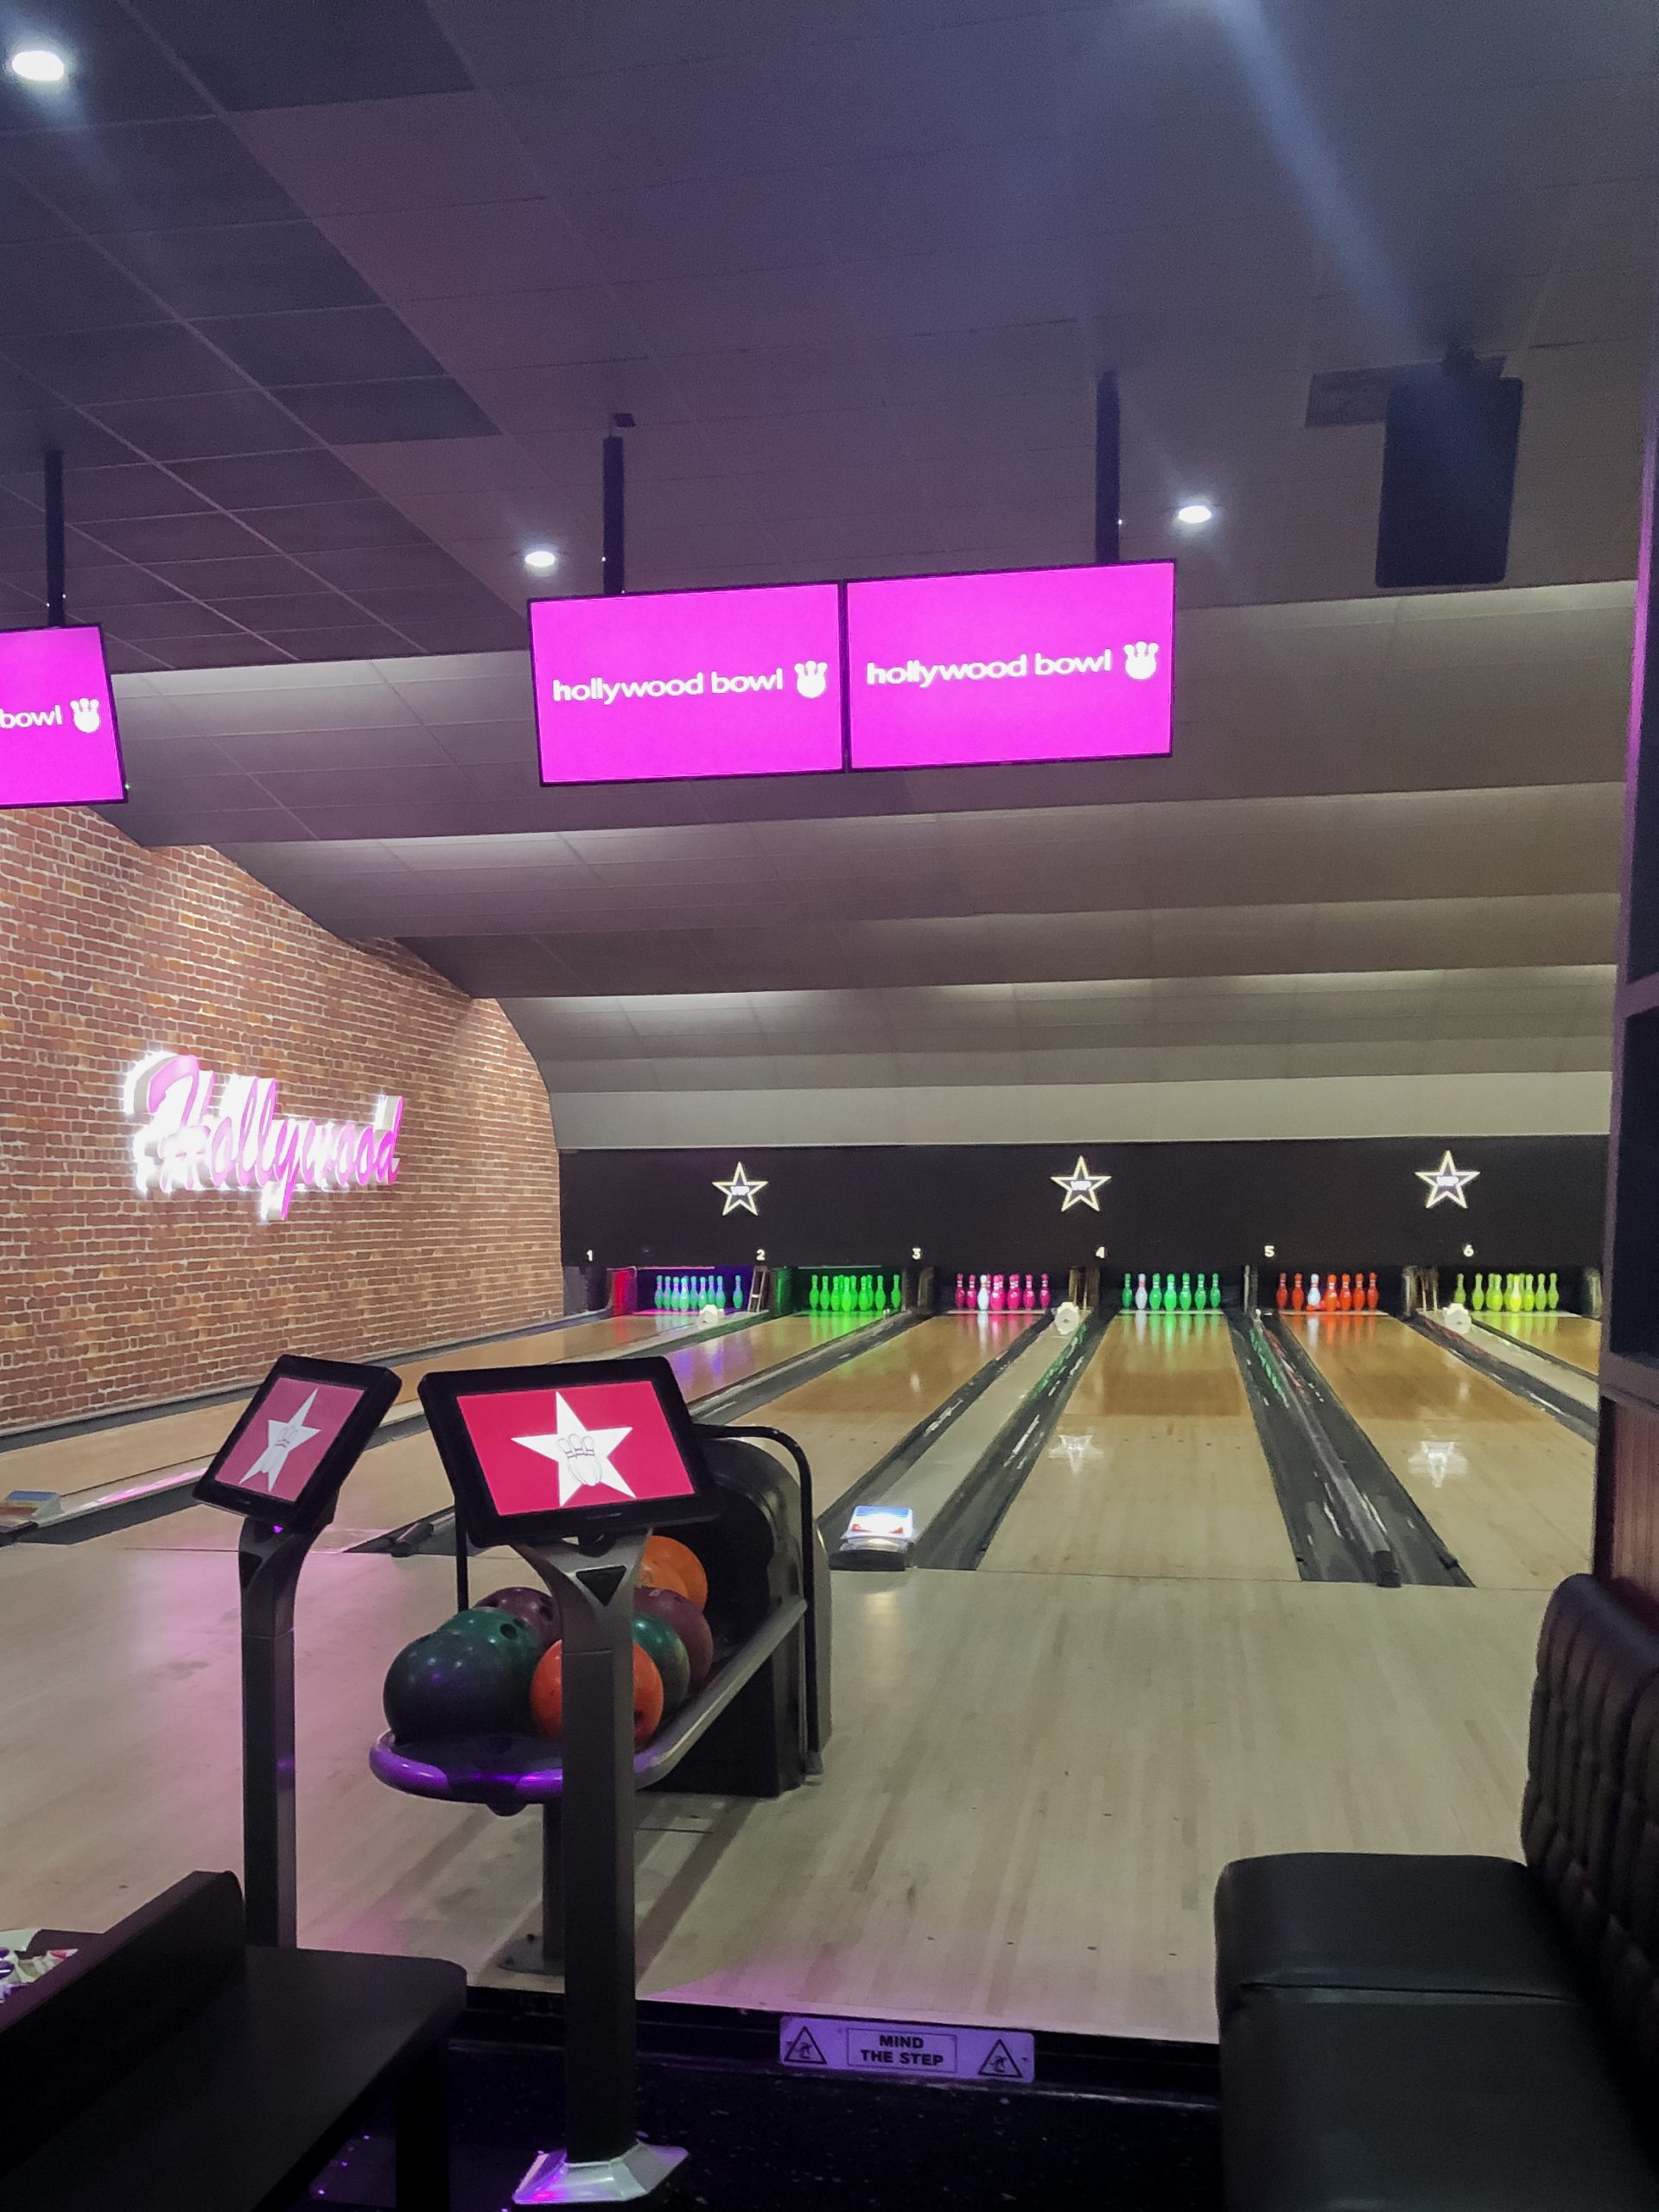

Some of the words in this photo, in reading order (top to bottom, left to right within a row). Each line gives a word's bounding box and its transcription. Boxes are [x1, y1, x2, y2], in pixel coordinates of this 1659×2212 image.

[866, 653, 1029, 689] hollywood
[1033, 648, 1113, 677] bowl
[552, 671, 705, 706] hollywood
[710, 667, 784, 694] bowl
[0, 705, 63, 729] bowl
[128, 1053, 404, 1221] Hollywood
[586, 1249, 594, 1262] 1
[756, 1249, 766, 1262] 2
[912, 1247, 921, 1260] 3
[1095, 1246, 1105, 1259] 4
[1264, 1245, 1275, 1258] 5
[1463, 1244, 1475, 1257] 6
[880, 2034, 924, 2050] MIND
[861, 2049, 893, 2063] THE
[899, 2051, 944, 2066] STEP
